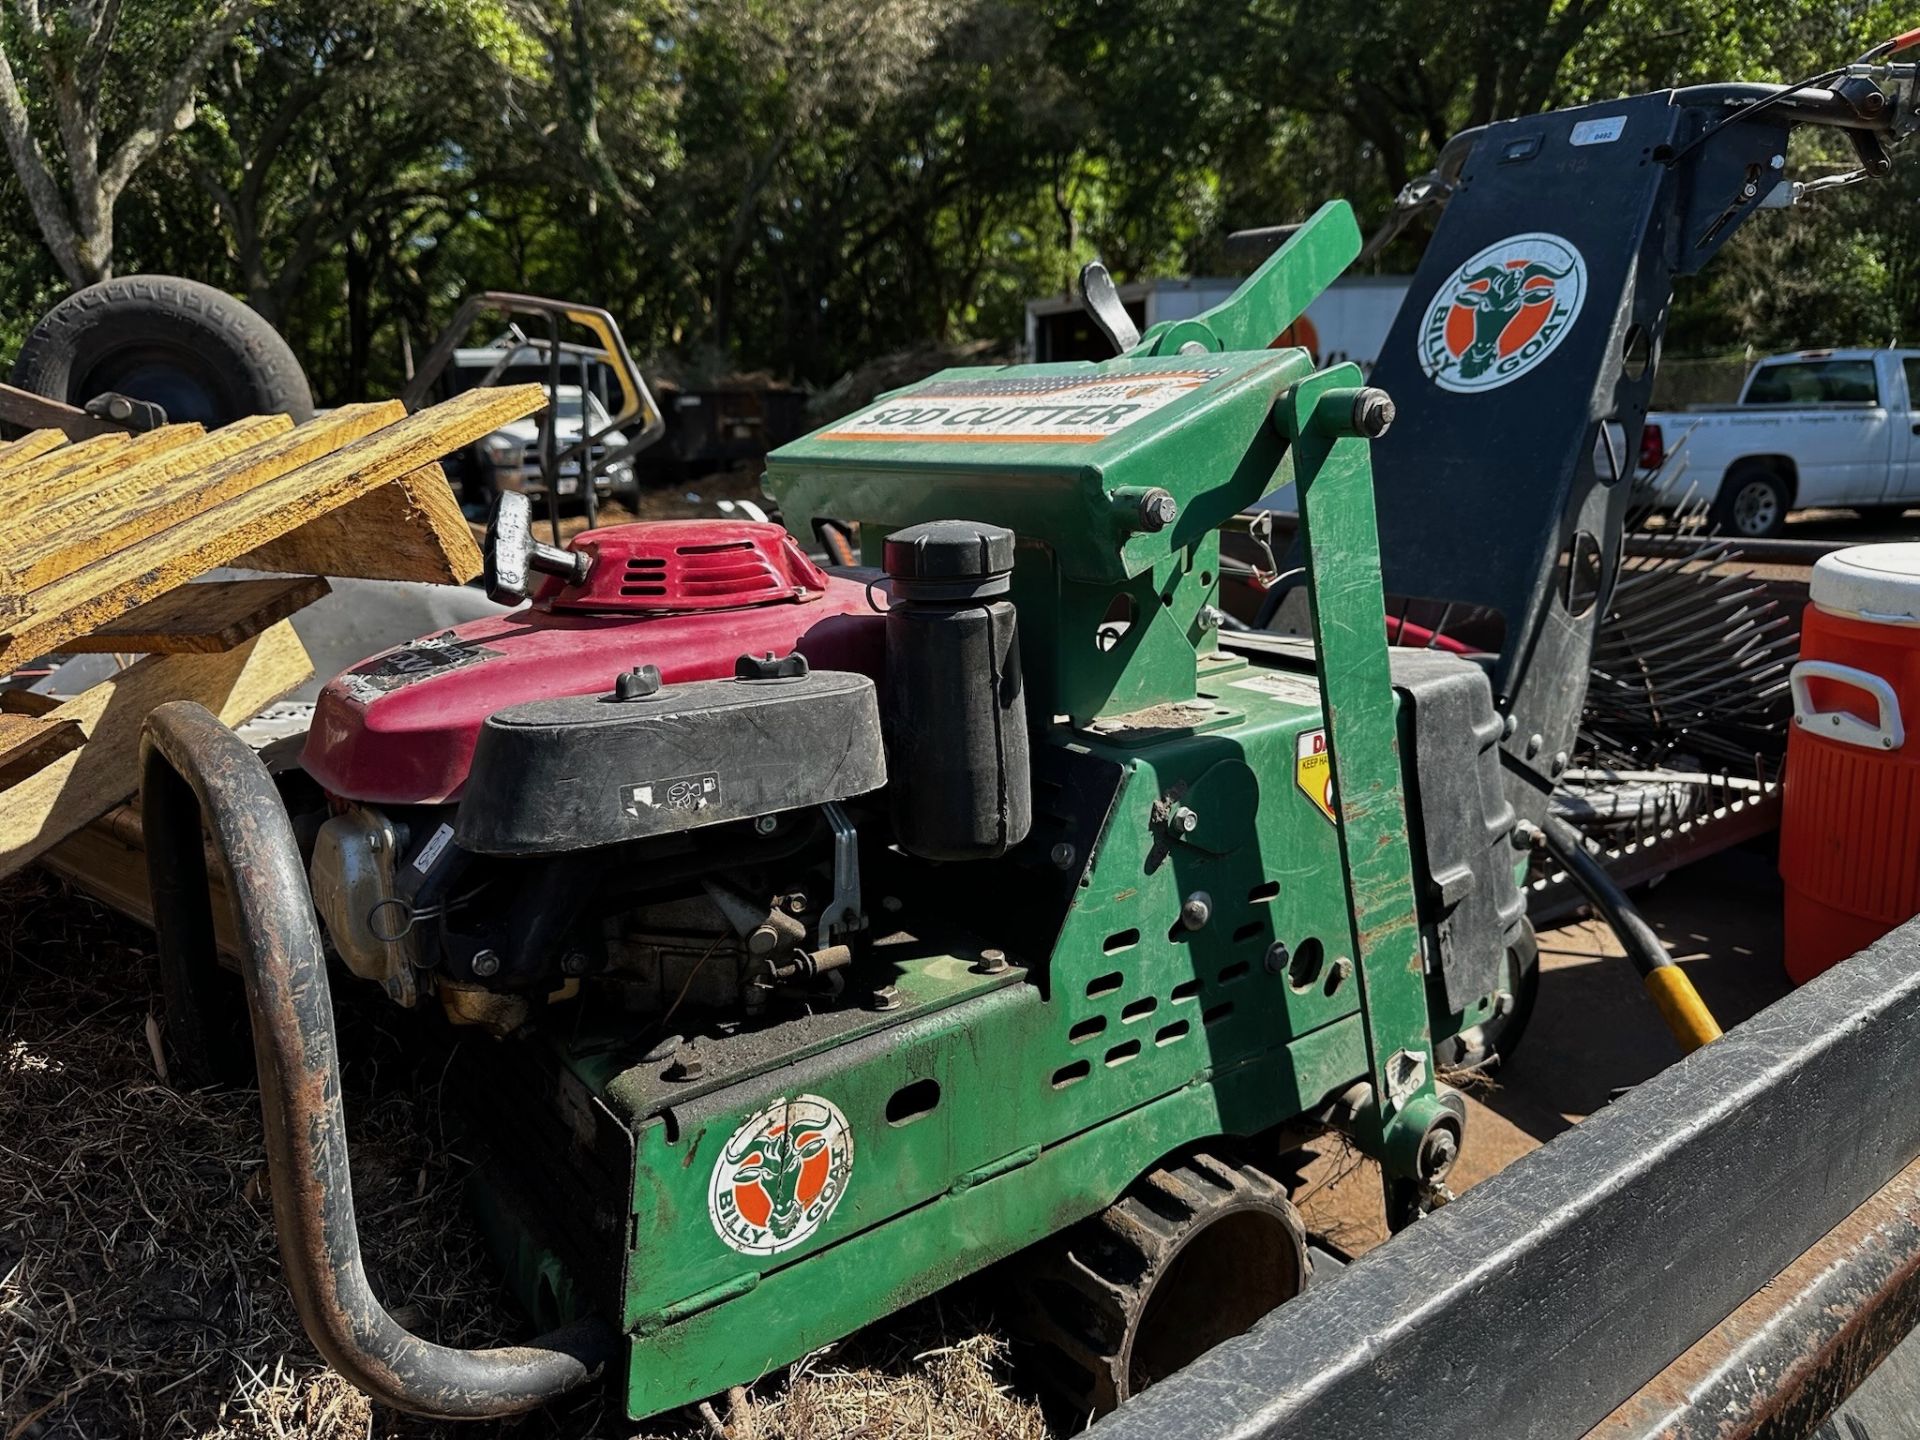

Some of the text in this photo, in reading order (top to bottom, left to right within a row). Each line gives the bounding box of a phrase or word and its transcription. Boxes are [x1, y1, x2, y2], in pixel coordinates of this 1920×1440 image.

[1428, 298, 1569, 375] BILLY GOAT
[857, 403, 1144, 427] SOD CUTTER
[1302, 757, 1319, 770] KEEP
[719, 1147, 848, 1244] BILLY GOAT
